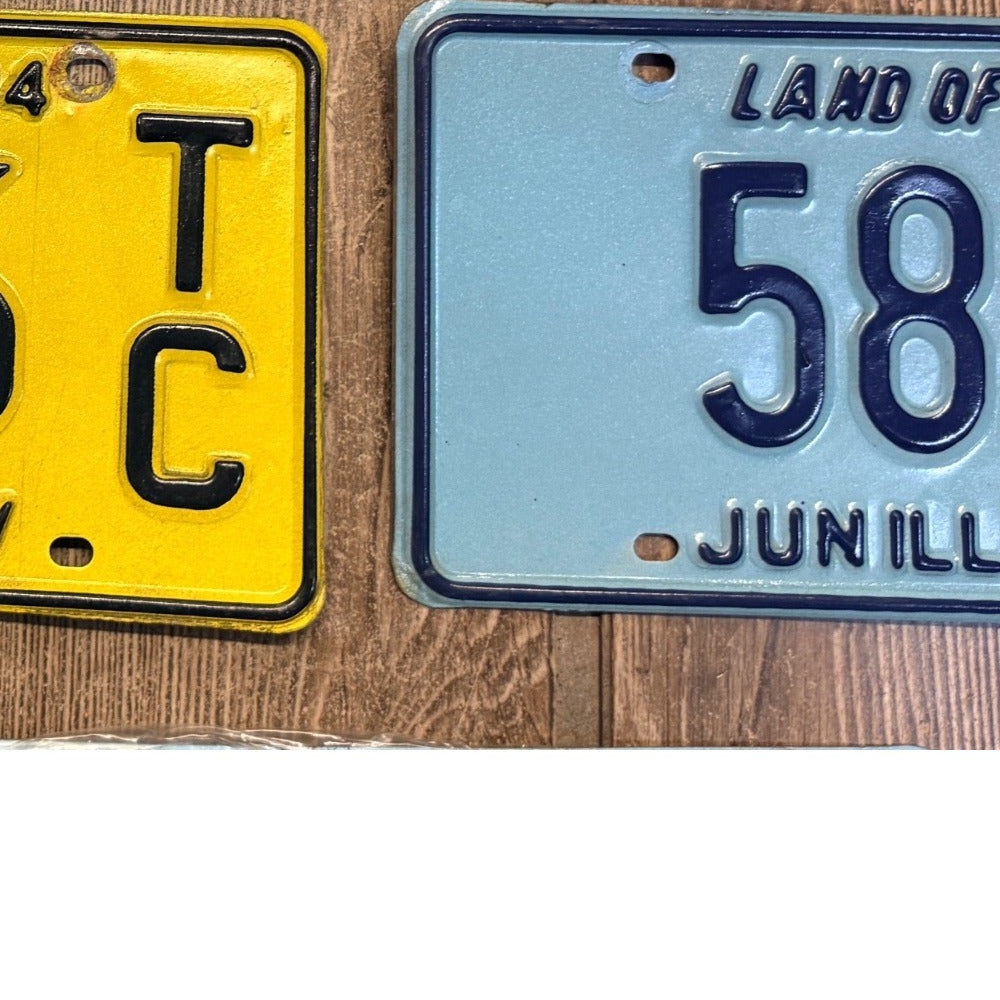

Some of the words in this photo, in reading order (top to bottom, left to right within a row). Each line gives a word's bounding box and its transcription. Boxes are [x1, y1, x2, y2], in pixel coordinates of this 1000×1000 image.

[731, 63, 910, 124] LAND
[929, 67, 1000, 124] OF
[699, 161, 986, 454] 58
[699, 507, 864, 567] JUN
